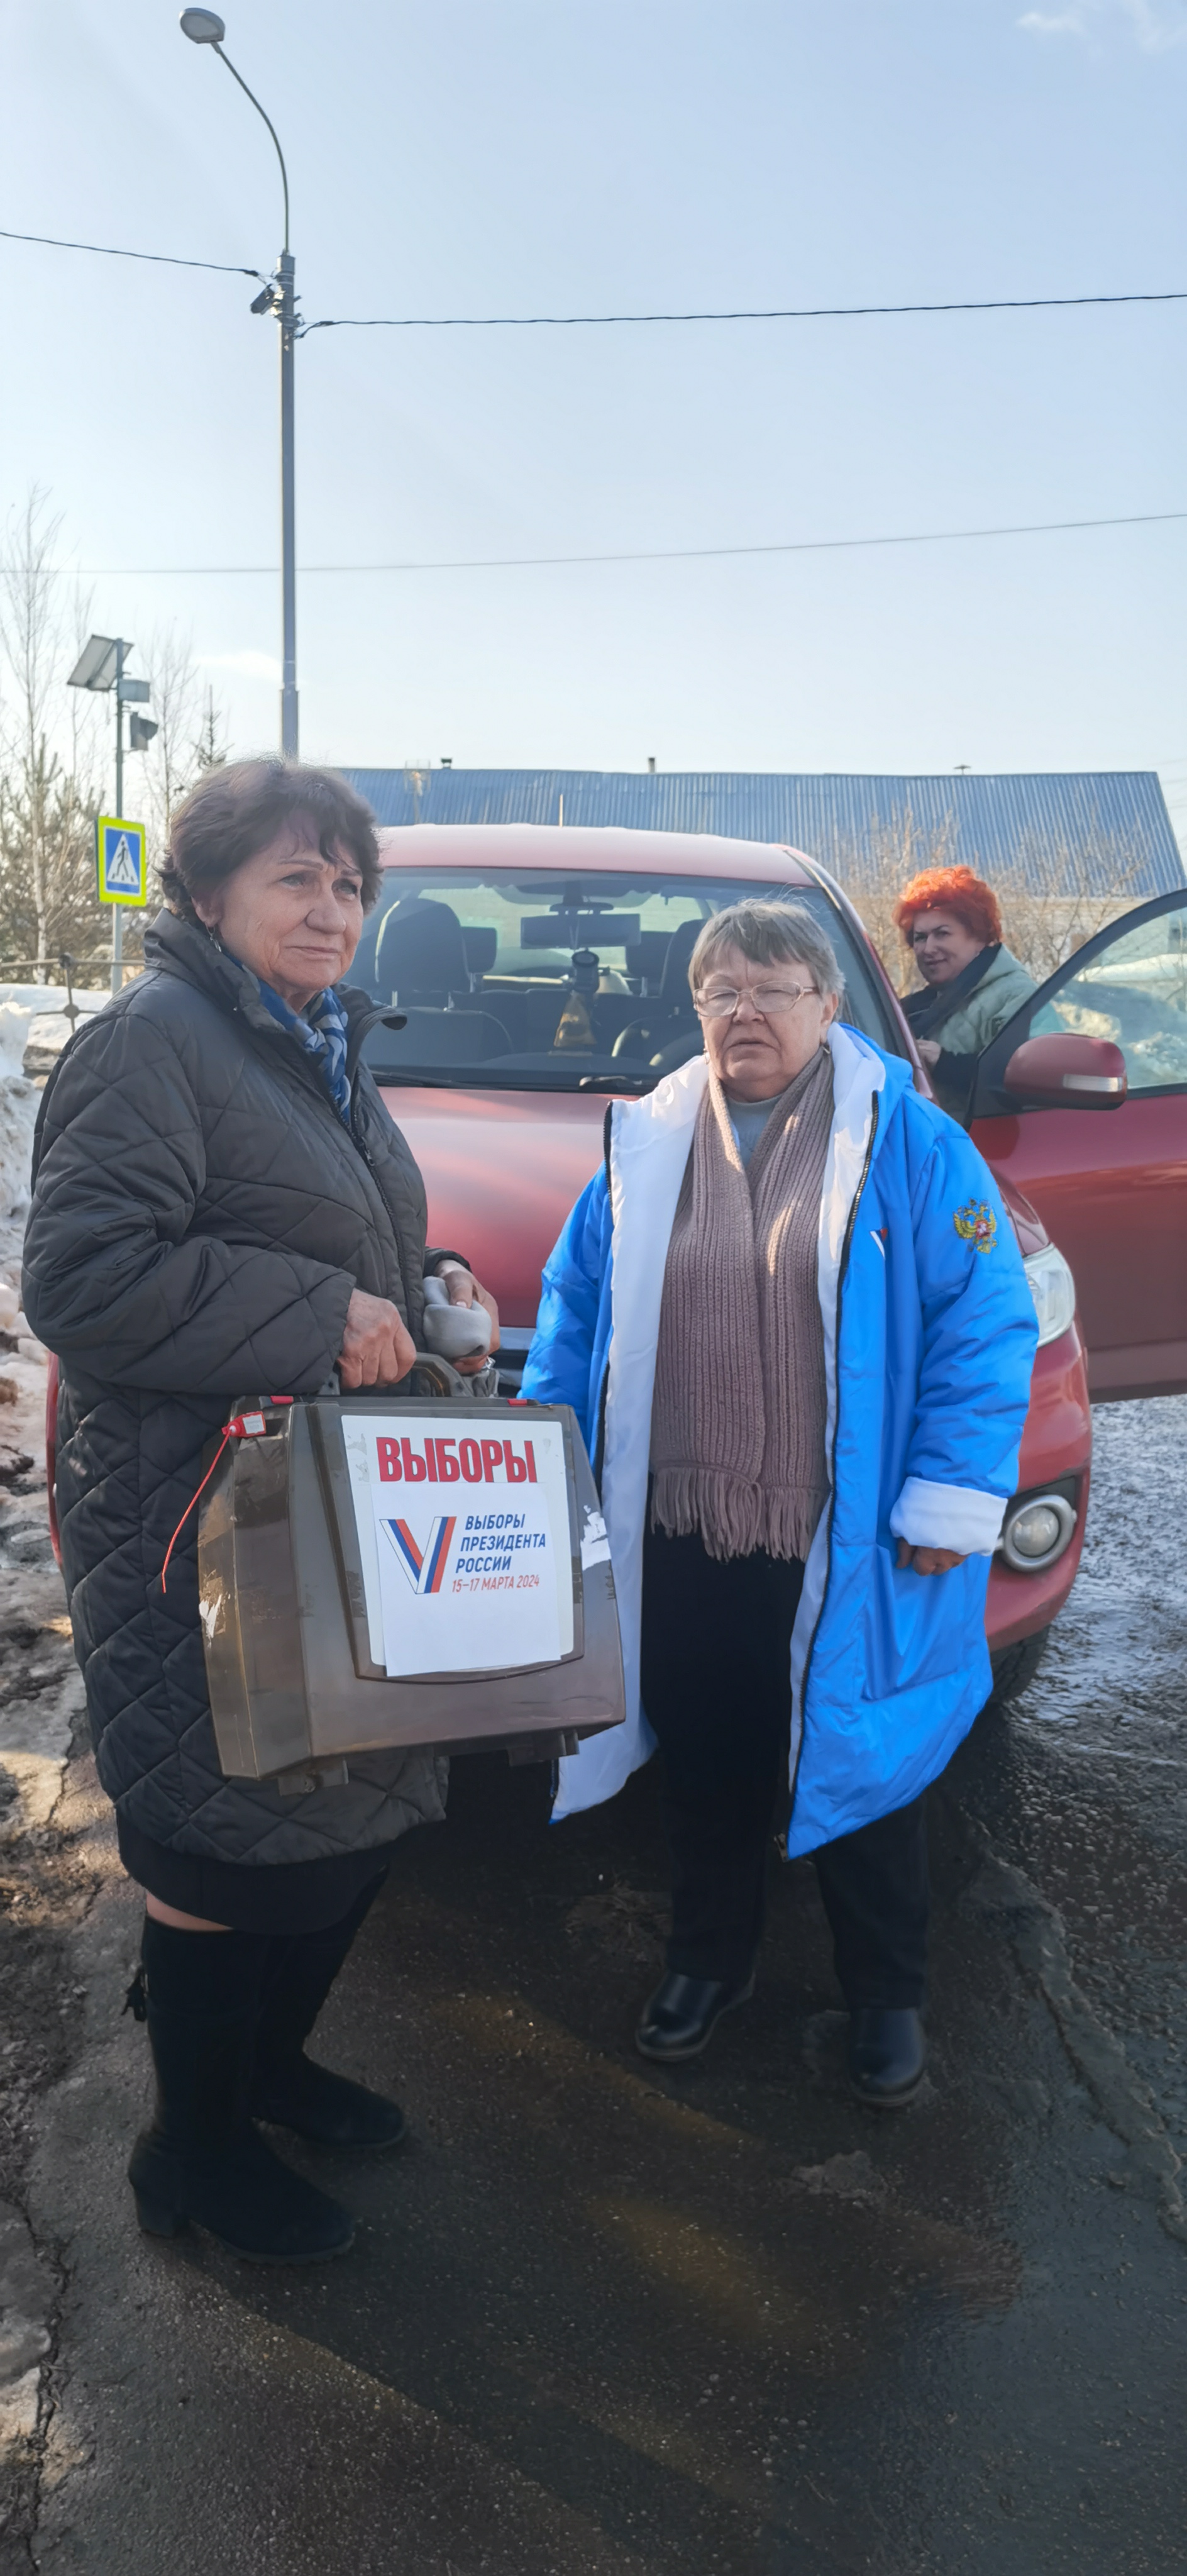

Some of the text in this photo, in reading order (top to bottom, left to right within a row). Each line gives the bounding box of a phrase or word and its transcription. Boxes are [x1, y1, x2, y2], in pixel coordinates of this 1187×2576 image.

[376, 1436, 538, 1483] ВЫБОРЫ
[465, 1513, 526, 1530] ВЫБОРЫ
[460, 1533, 546, 1552] ПРЕЗИДЕНТА
[455, 1555, 512, 1574] РОССИИ
[481, 1576, 514, 1591] МАРТА
[516, 1574, 539, 1589] 2024
